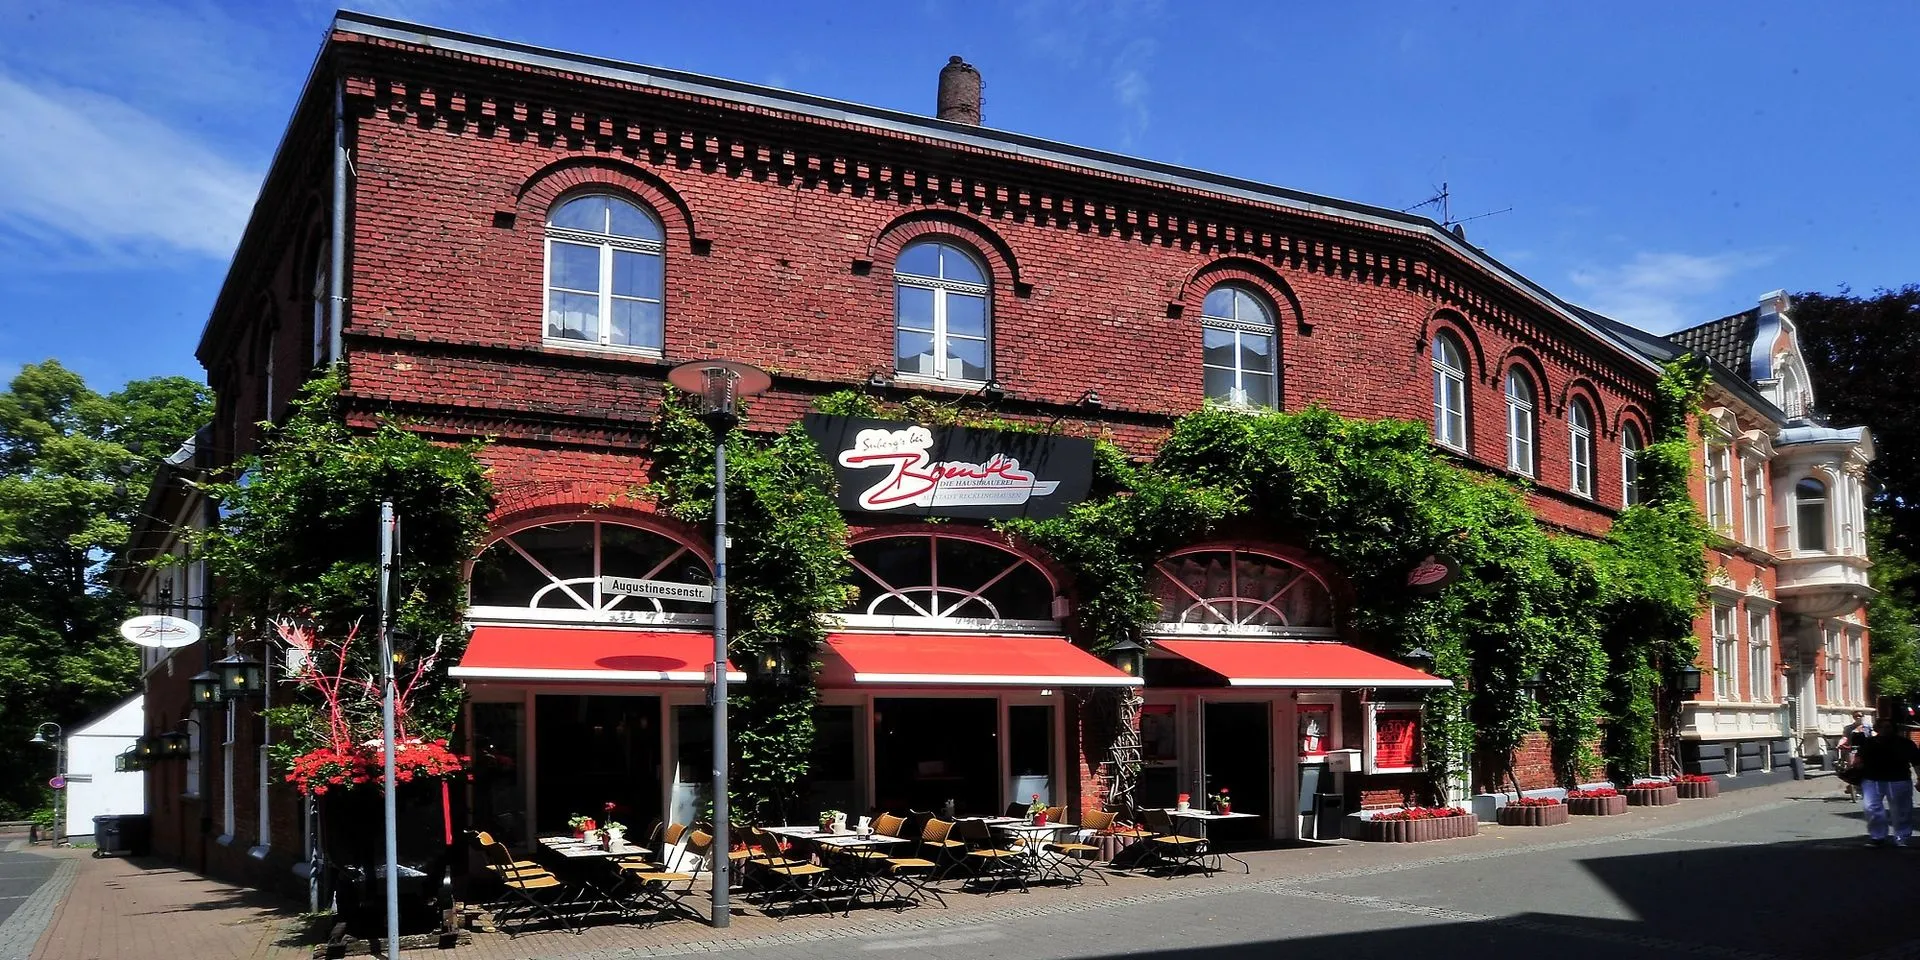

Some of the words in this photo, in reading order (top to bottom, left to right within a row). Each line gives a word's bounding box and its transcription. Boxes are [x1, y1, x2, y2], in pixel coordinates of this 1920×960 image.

[910, 432, 924, 444] bei
[955, 479, 1015, 487] HAUSBRAUEREI
[612, 579, 705, 598] Augustinessenstr.
